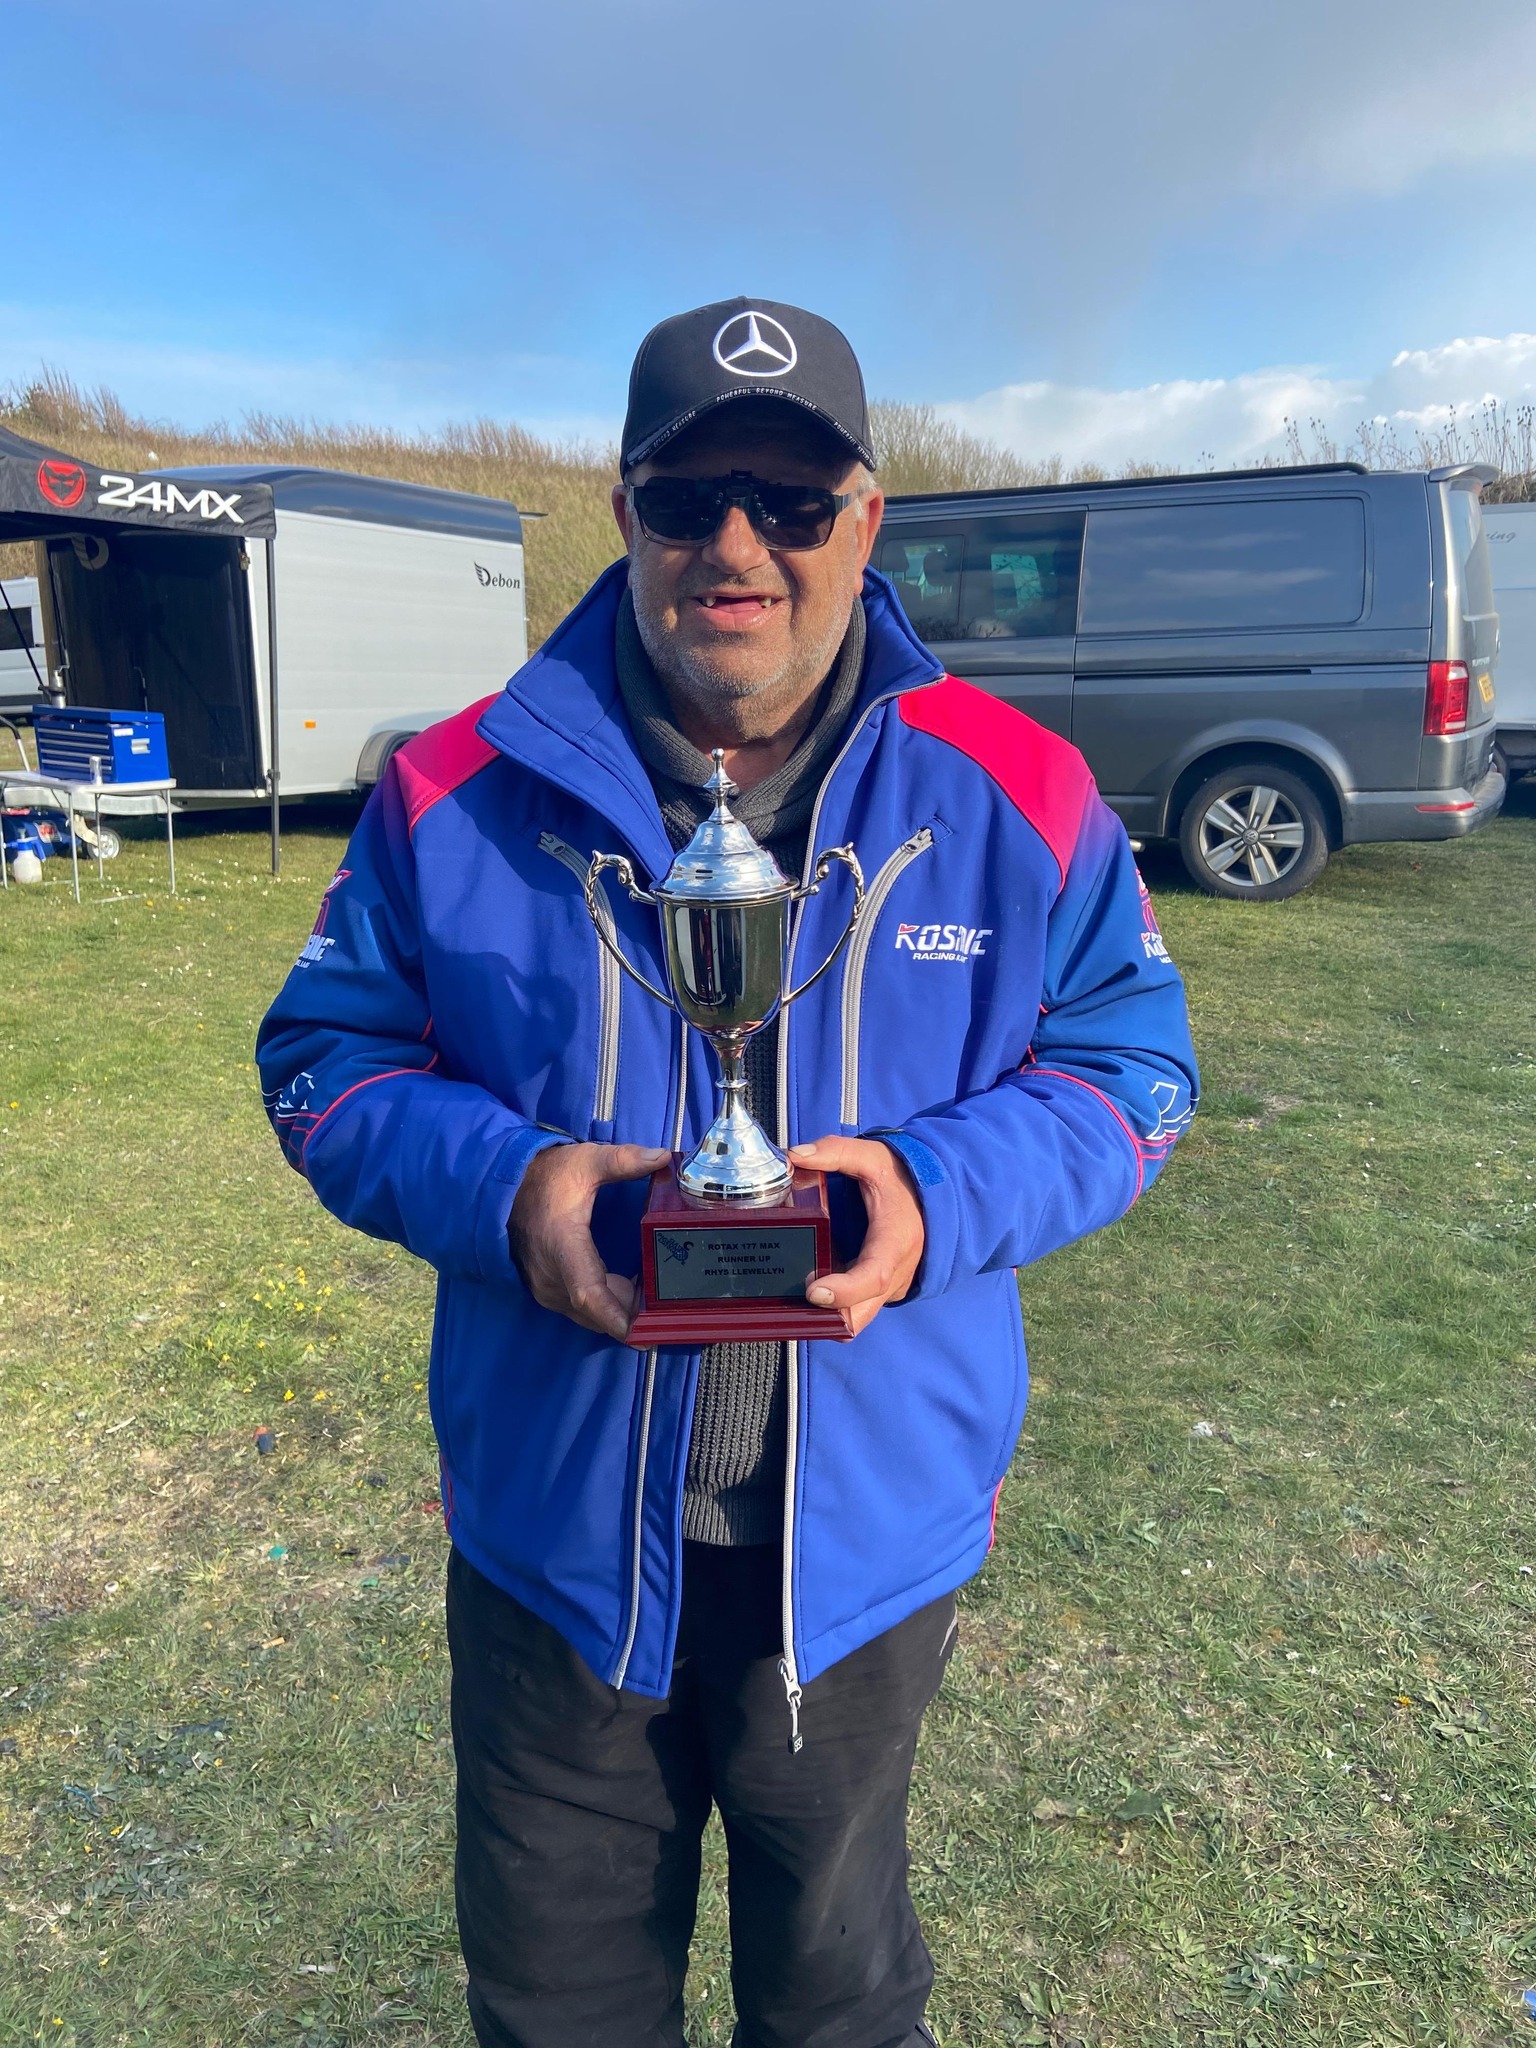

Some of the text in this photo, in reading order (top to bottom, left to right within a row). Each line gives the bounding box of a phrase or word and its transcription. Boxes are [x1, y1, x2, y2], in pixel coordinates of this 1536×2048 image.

[716, 387, 817, 411] POWERFUL BEYOND MEASURE
[98, 474, 245, 524] 24MX
[474, 560, 521, 589] Debon
[912, 952, 956, 961] RACING
[707, 1242, 781, 1251] ROTAX 177 MAX
[717, 1255, 756, 1263] RUNNER
[732, 1267, 785, 1275] LLEWELLYN
